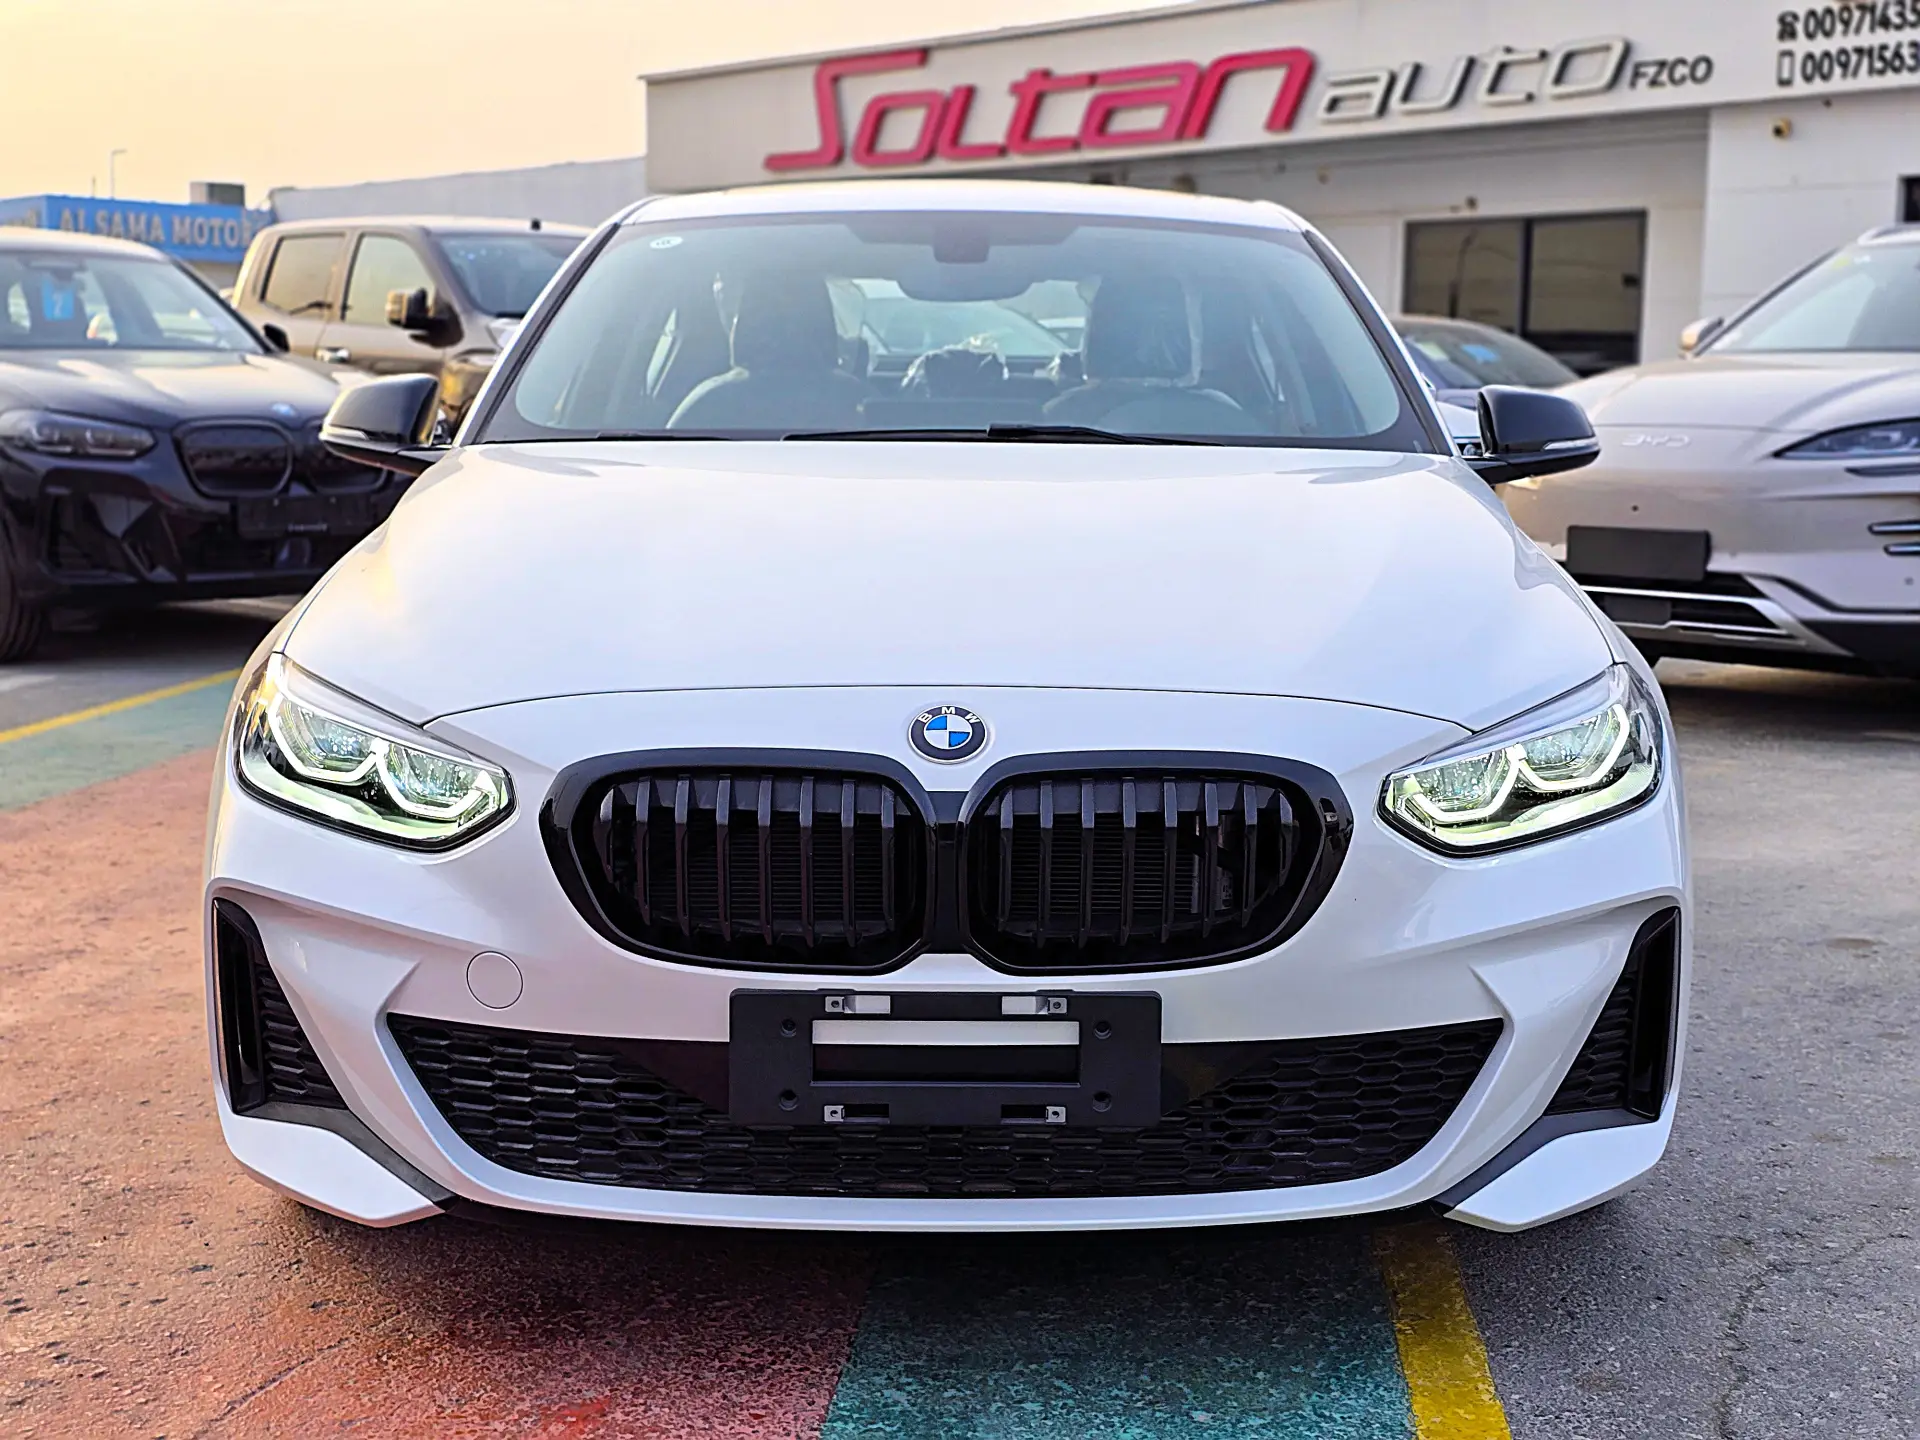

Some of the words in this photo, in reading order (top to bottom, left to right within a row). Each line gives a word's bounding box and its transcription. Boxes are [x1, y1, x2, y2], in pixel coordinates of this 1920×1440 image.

[1316, 34, 1633, 124] auto
[1628, 54, 1715, 91] FZCO
[95, 208, 166, 243] SAMA
[917, 706, 981, 724] BMW
